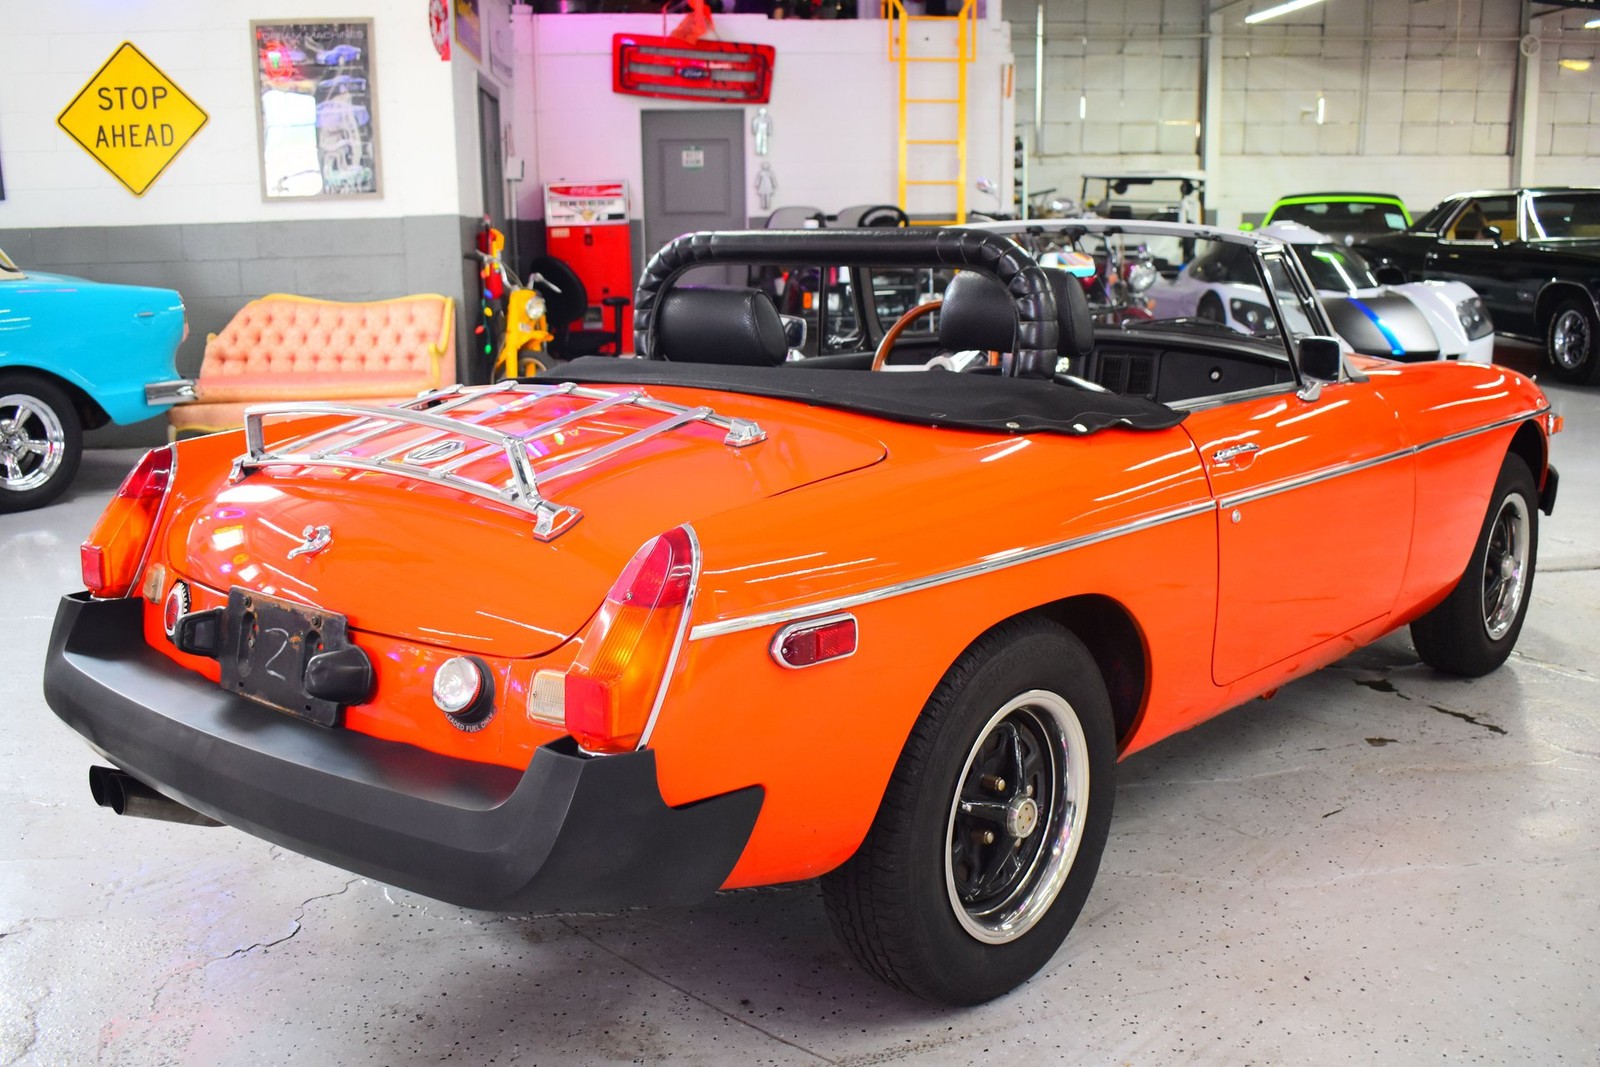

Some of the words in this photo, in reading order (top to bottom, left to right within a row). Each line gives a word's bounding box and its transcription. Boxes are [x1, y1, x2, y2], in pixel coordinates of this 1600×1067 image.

[97, 86, 168, 111] STOP
[95, 123, 174, 149] AHEAD
[264, 627, 289, 681] 2
[465, 724, 481, 733] FUEL
[480, 712, 494, 729] ONLY
